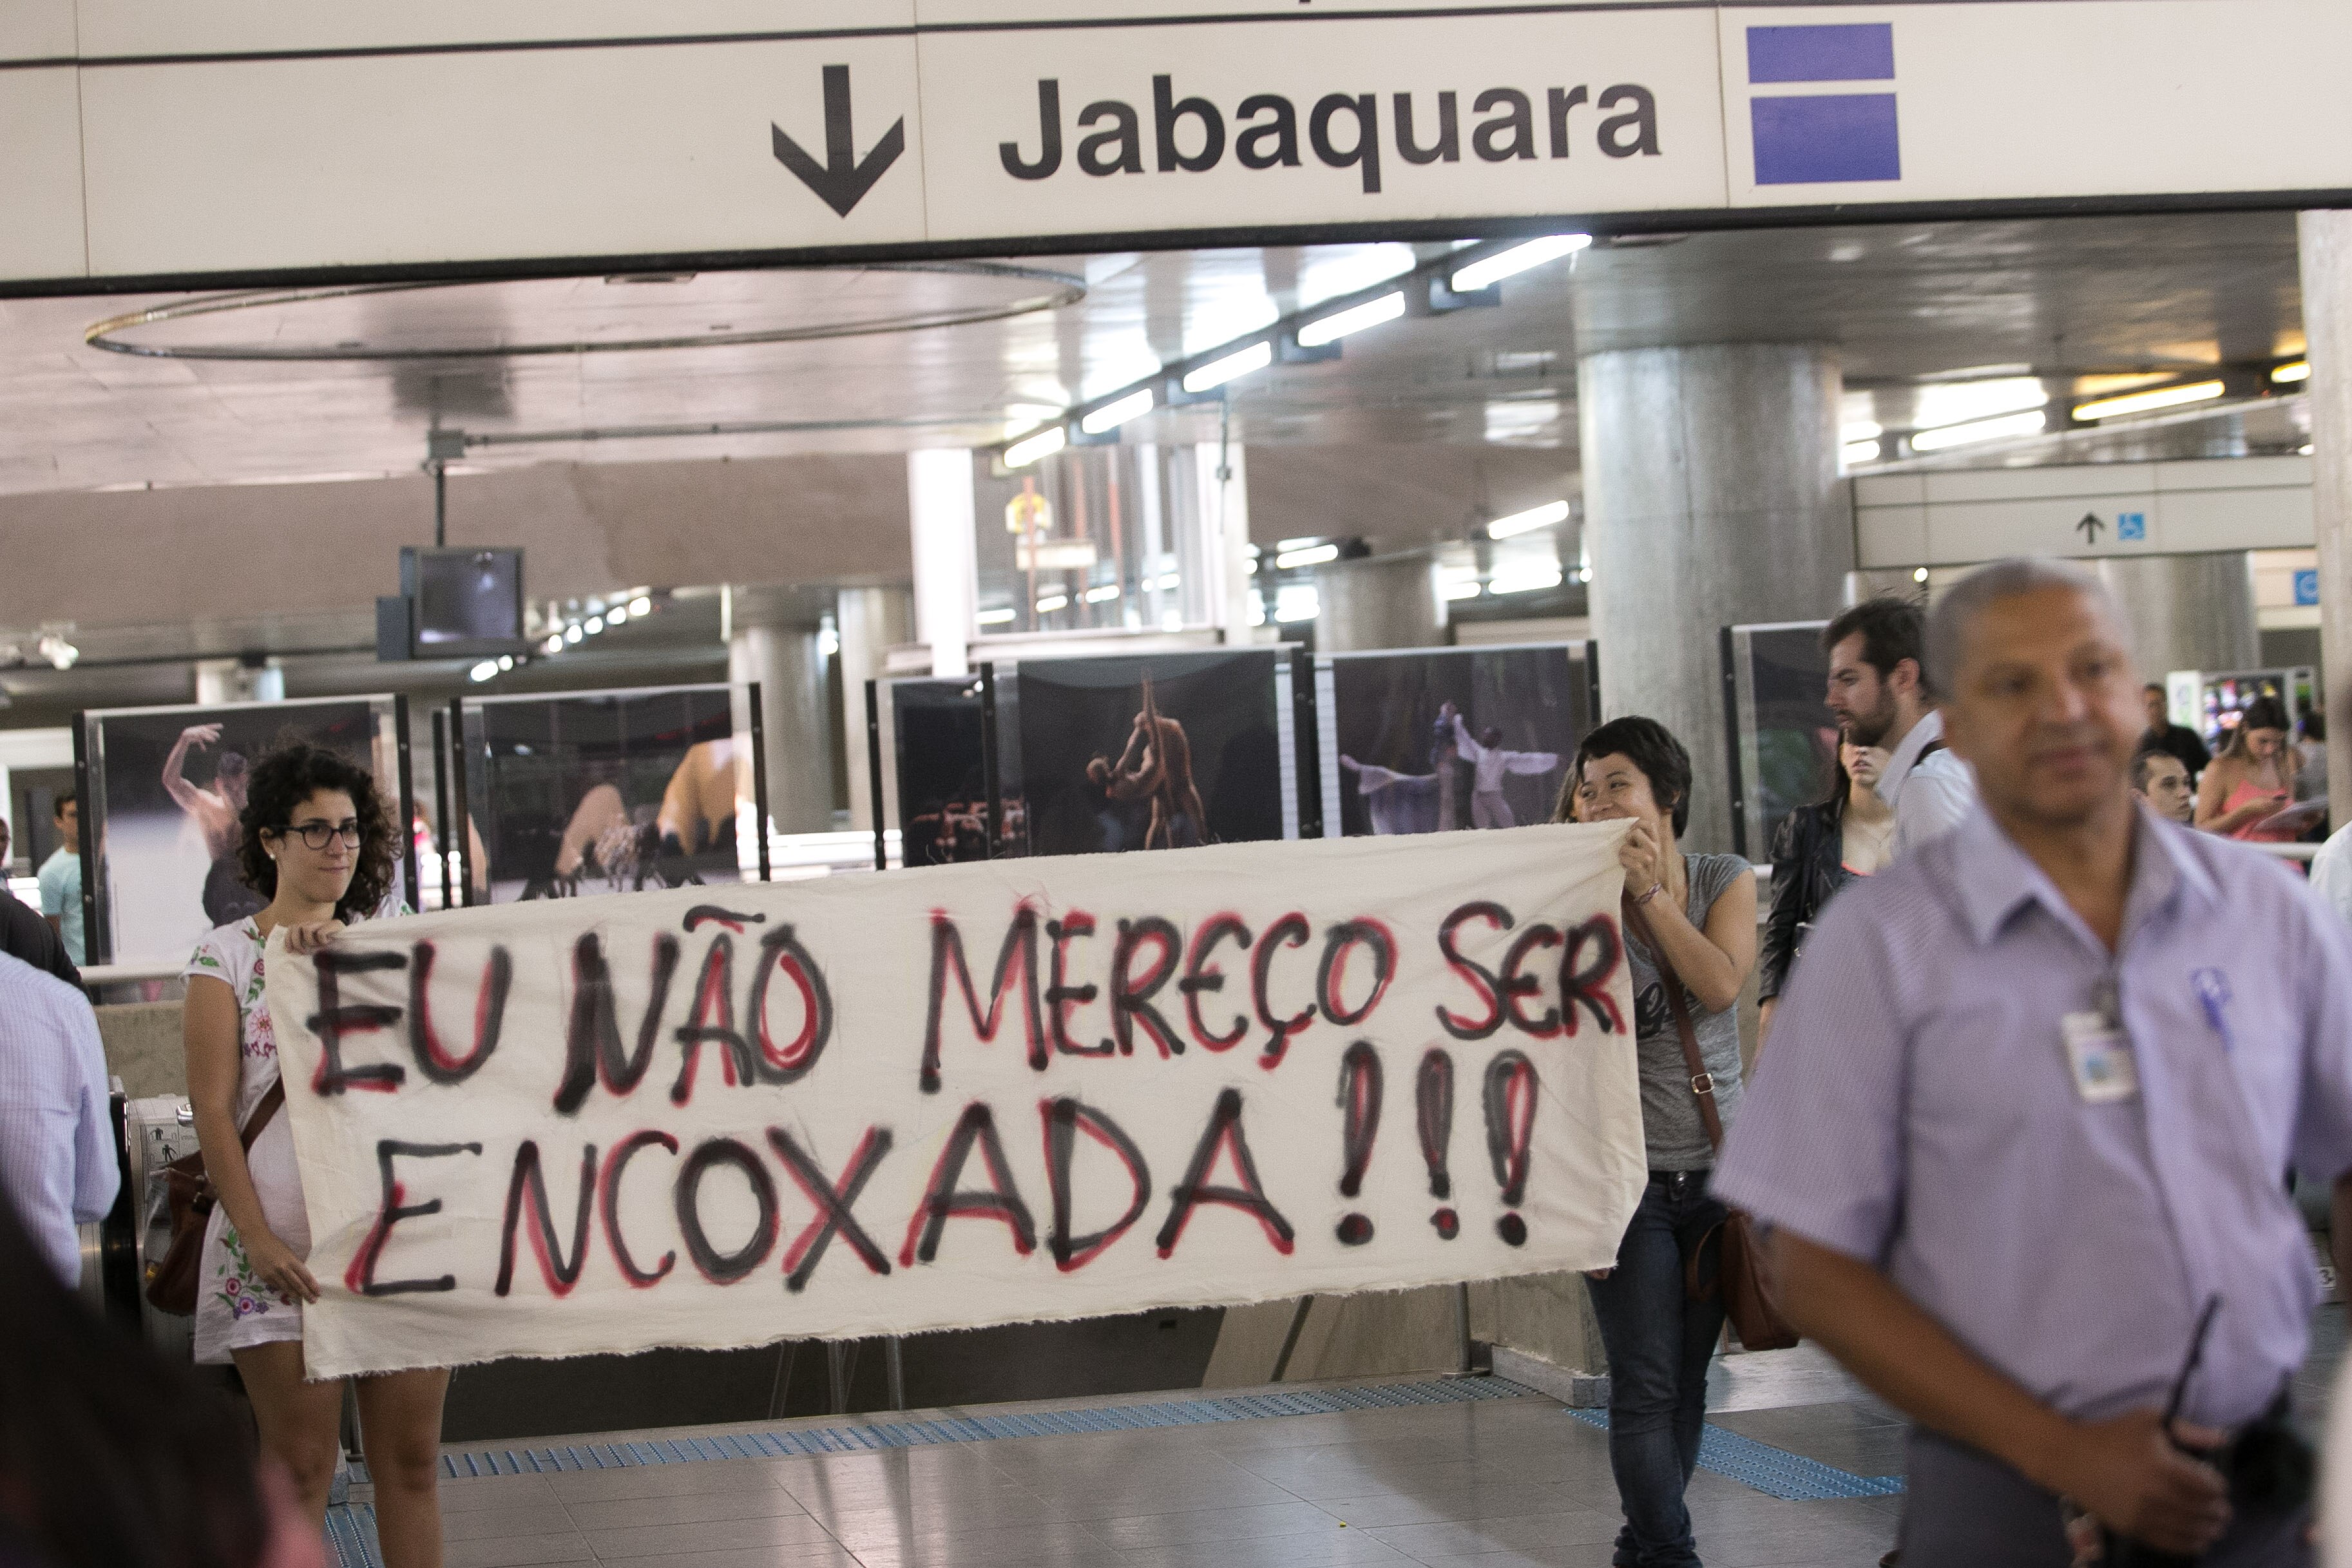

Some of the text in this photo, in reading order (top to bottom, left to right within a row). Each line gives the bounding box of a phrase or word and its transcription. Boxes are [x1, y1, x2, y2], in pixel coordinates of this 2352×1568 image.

[999, 74, 1661, 194] Jabaquara
[307, 901, 1627, 1114] EU NÃO MEREÇO SER
